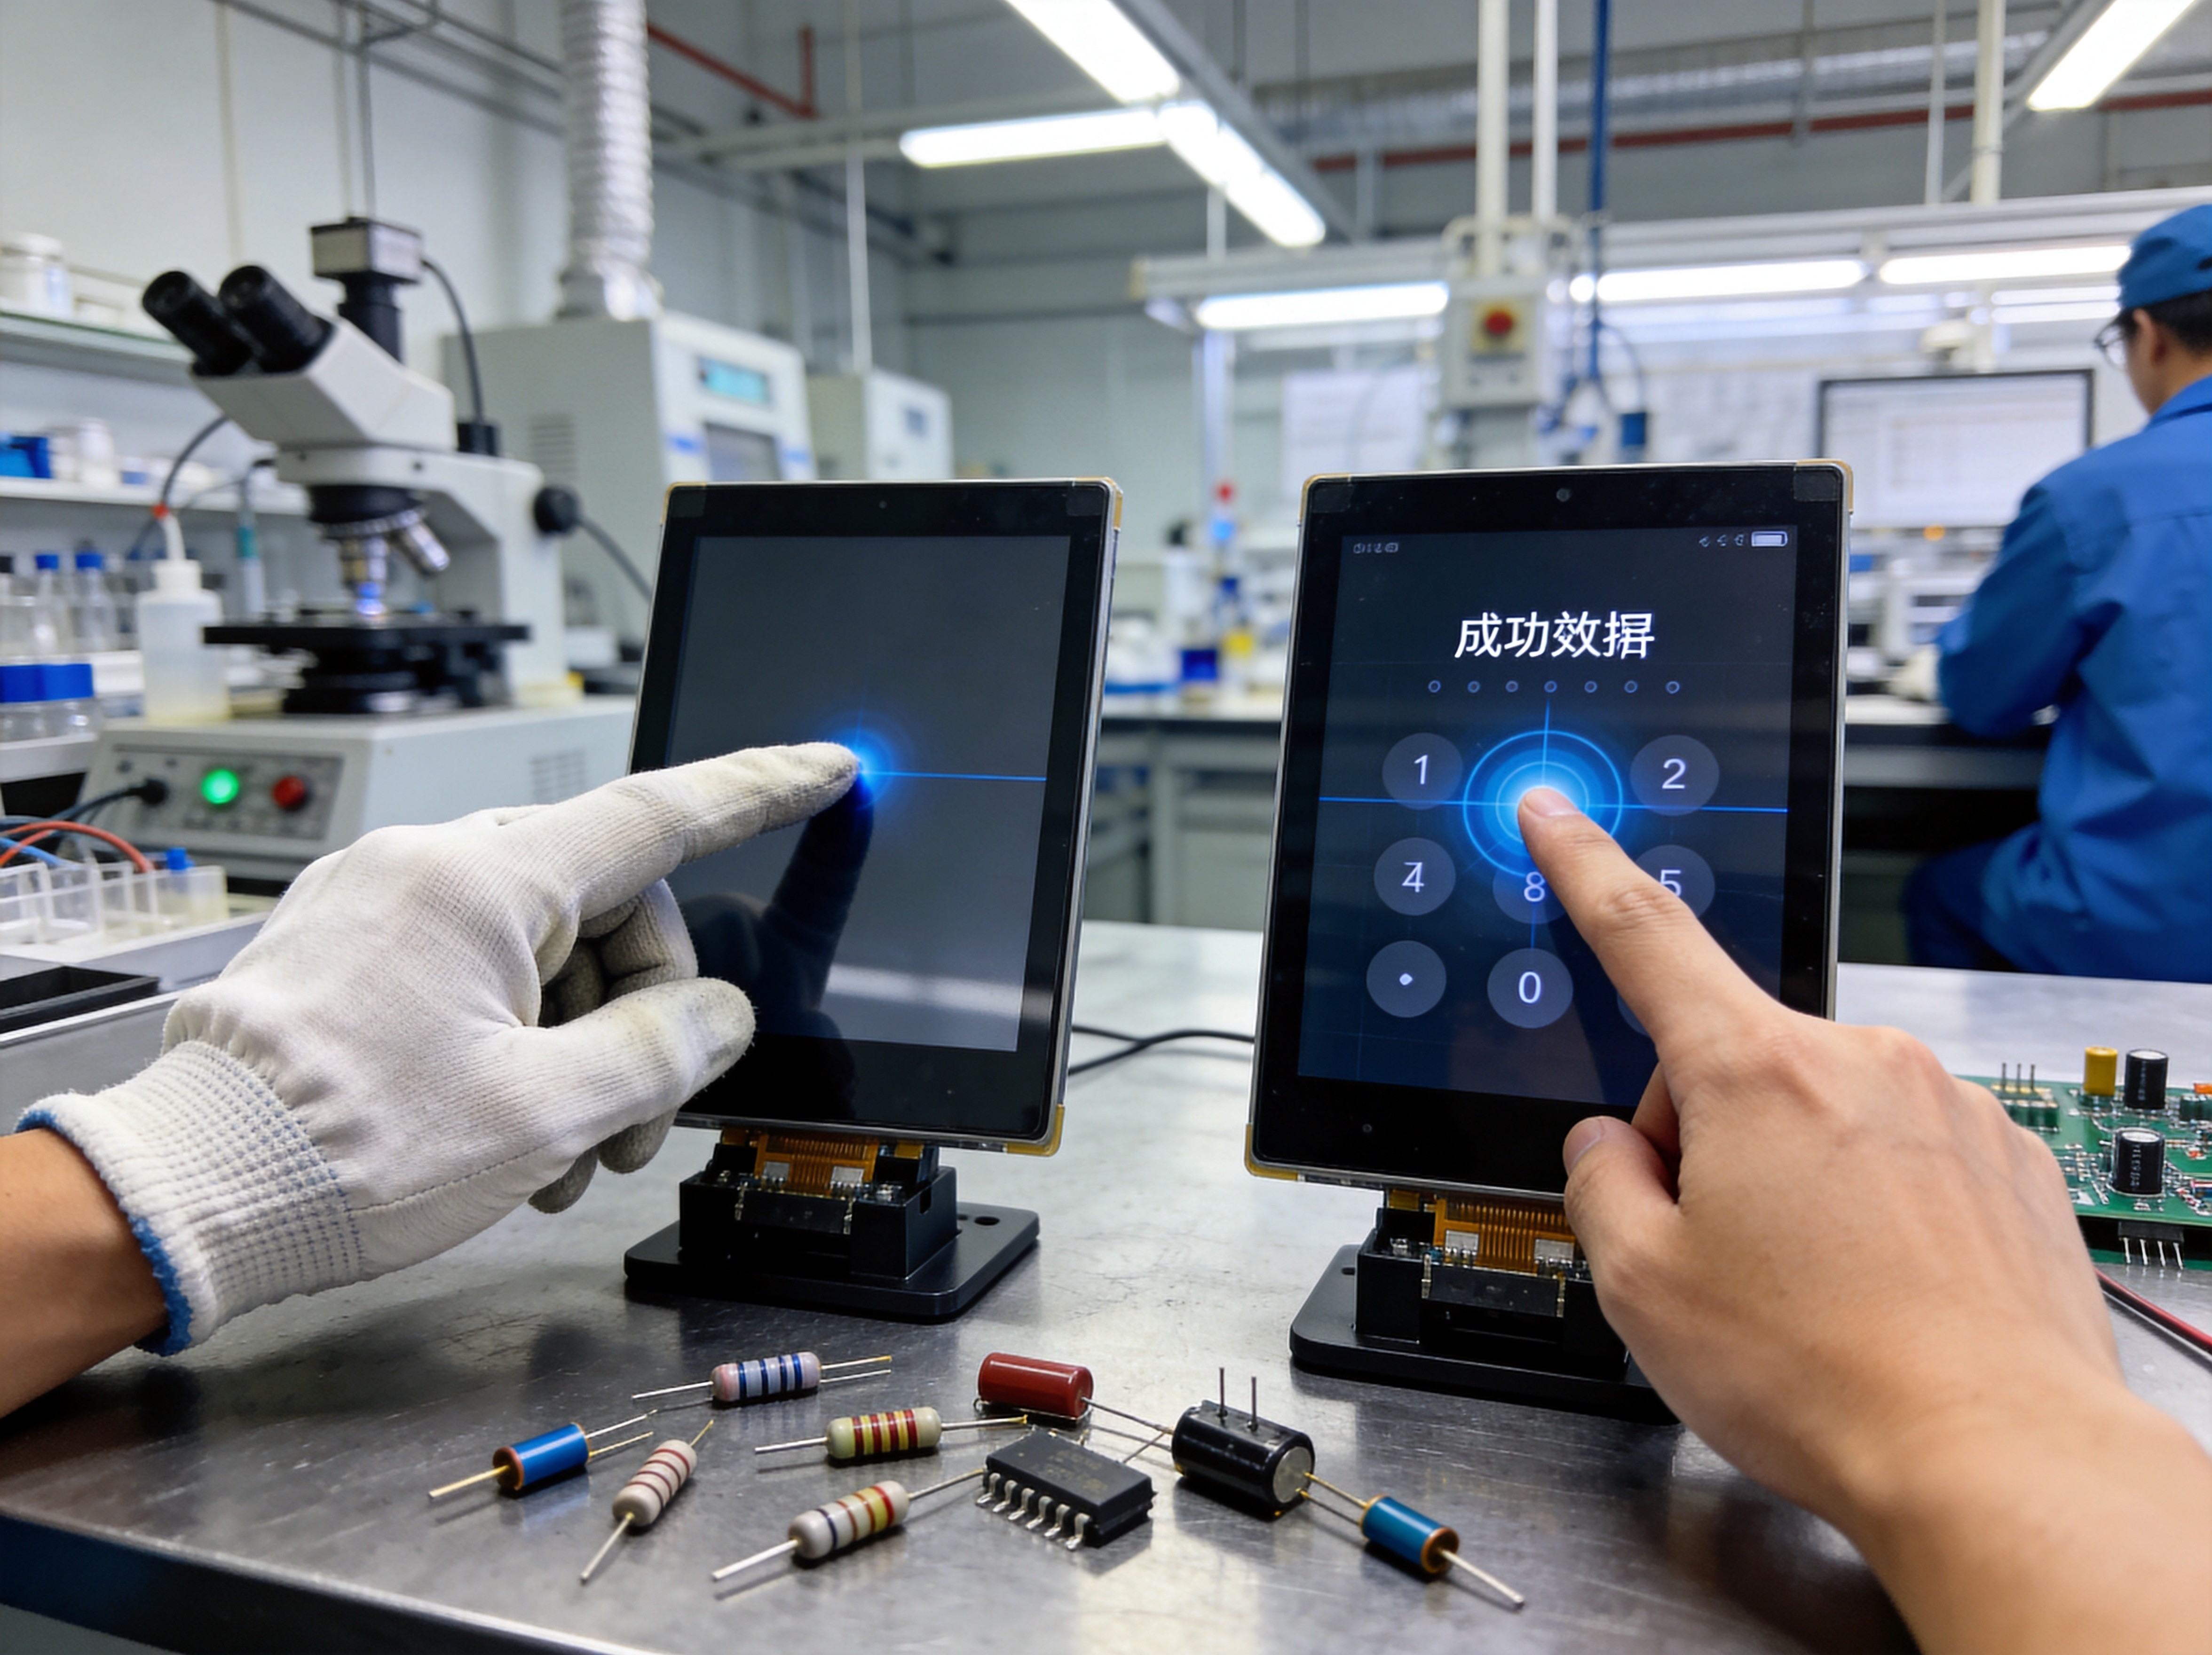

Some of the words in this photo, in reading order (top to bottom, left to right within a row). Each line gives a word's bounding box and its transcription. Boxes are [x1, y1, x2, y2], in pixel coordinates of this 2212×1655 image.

[1414, 754, 1428, 785] 1
[1661, 758, 1686, 789] 2
[1524, 871, 1546, 902] 8
[1660, 869, 1682, 898] 5
[1518, 971, 1541, 1004] 0
